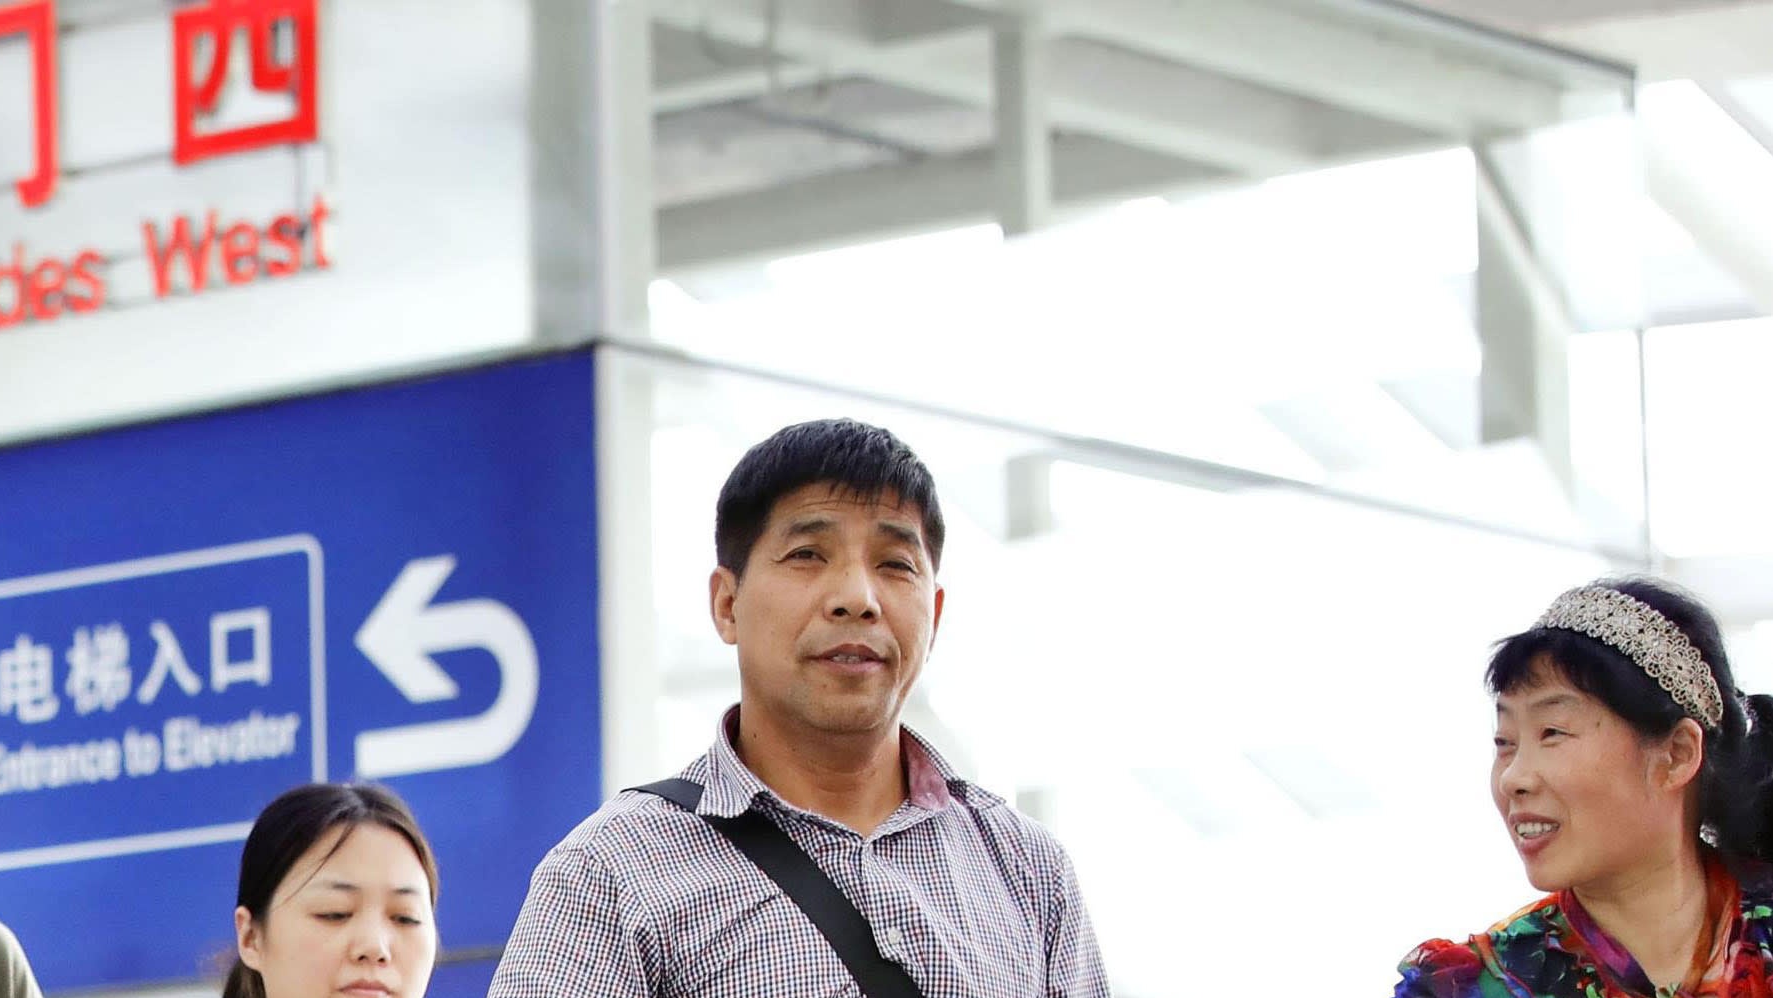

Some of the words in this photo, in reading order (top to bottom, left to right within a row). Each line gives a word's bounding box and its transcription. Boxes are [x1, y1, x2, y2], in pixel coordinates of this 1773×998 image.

[140, 194, 332, 299] West
[123, 726, 162, 778] to
[163, 709, 301, 773] Elevator
